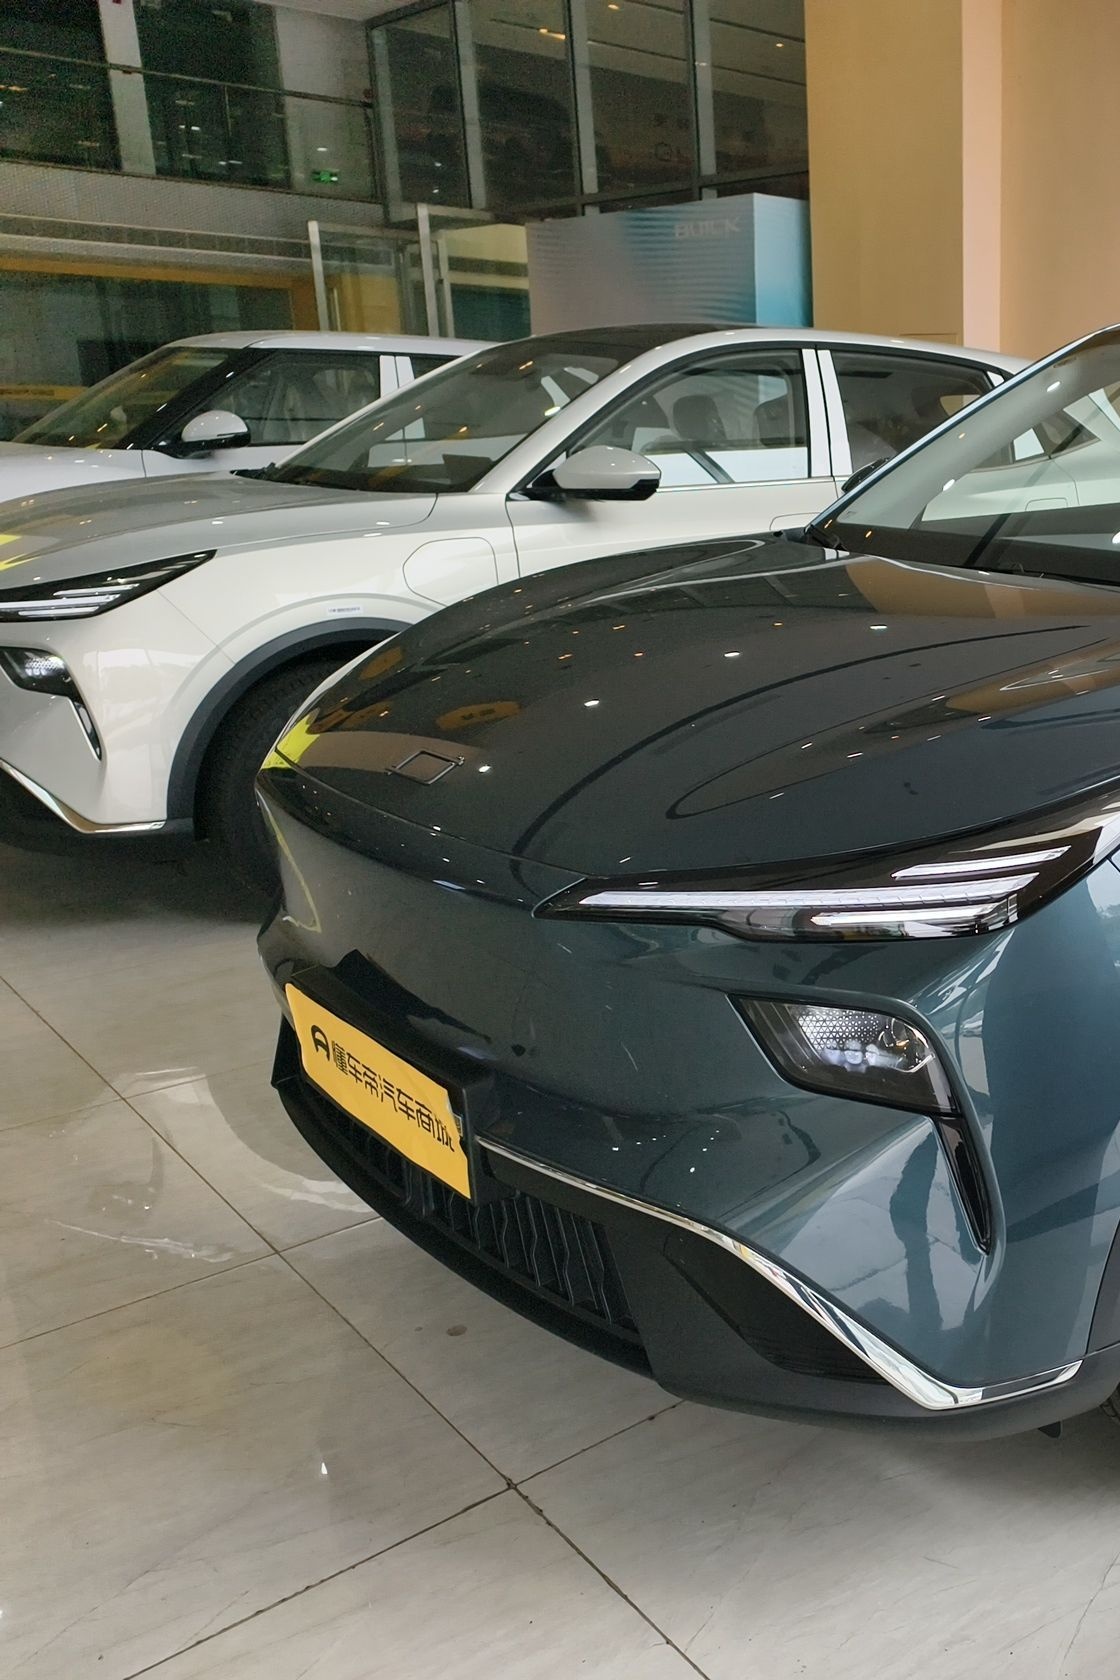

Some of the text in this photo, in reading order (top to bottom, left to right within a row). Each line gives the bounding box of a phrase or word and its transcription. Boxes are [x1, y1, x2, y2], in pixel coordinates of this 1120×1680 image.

[675, 216, 741, 238] BUICK
[331, 1039, 456, 1153] 懂车帝汽车商城
